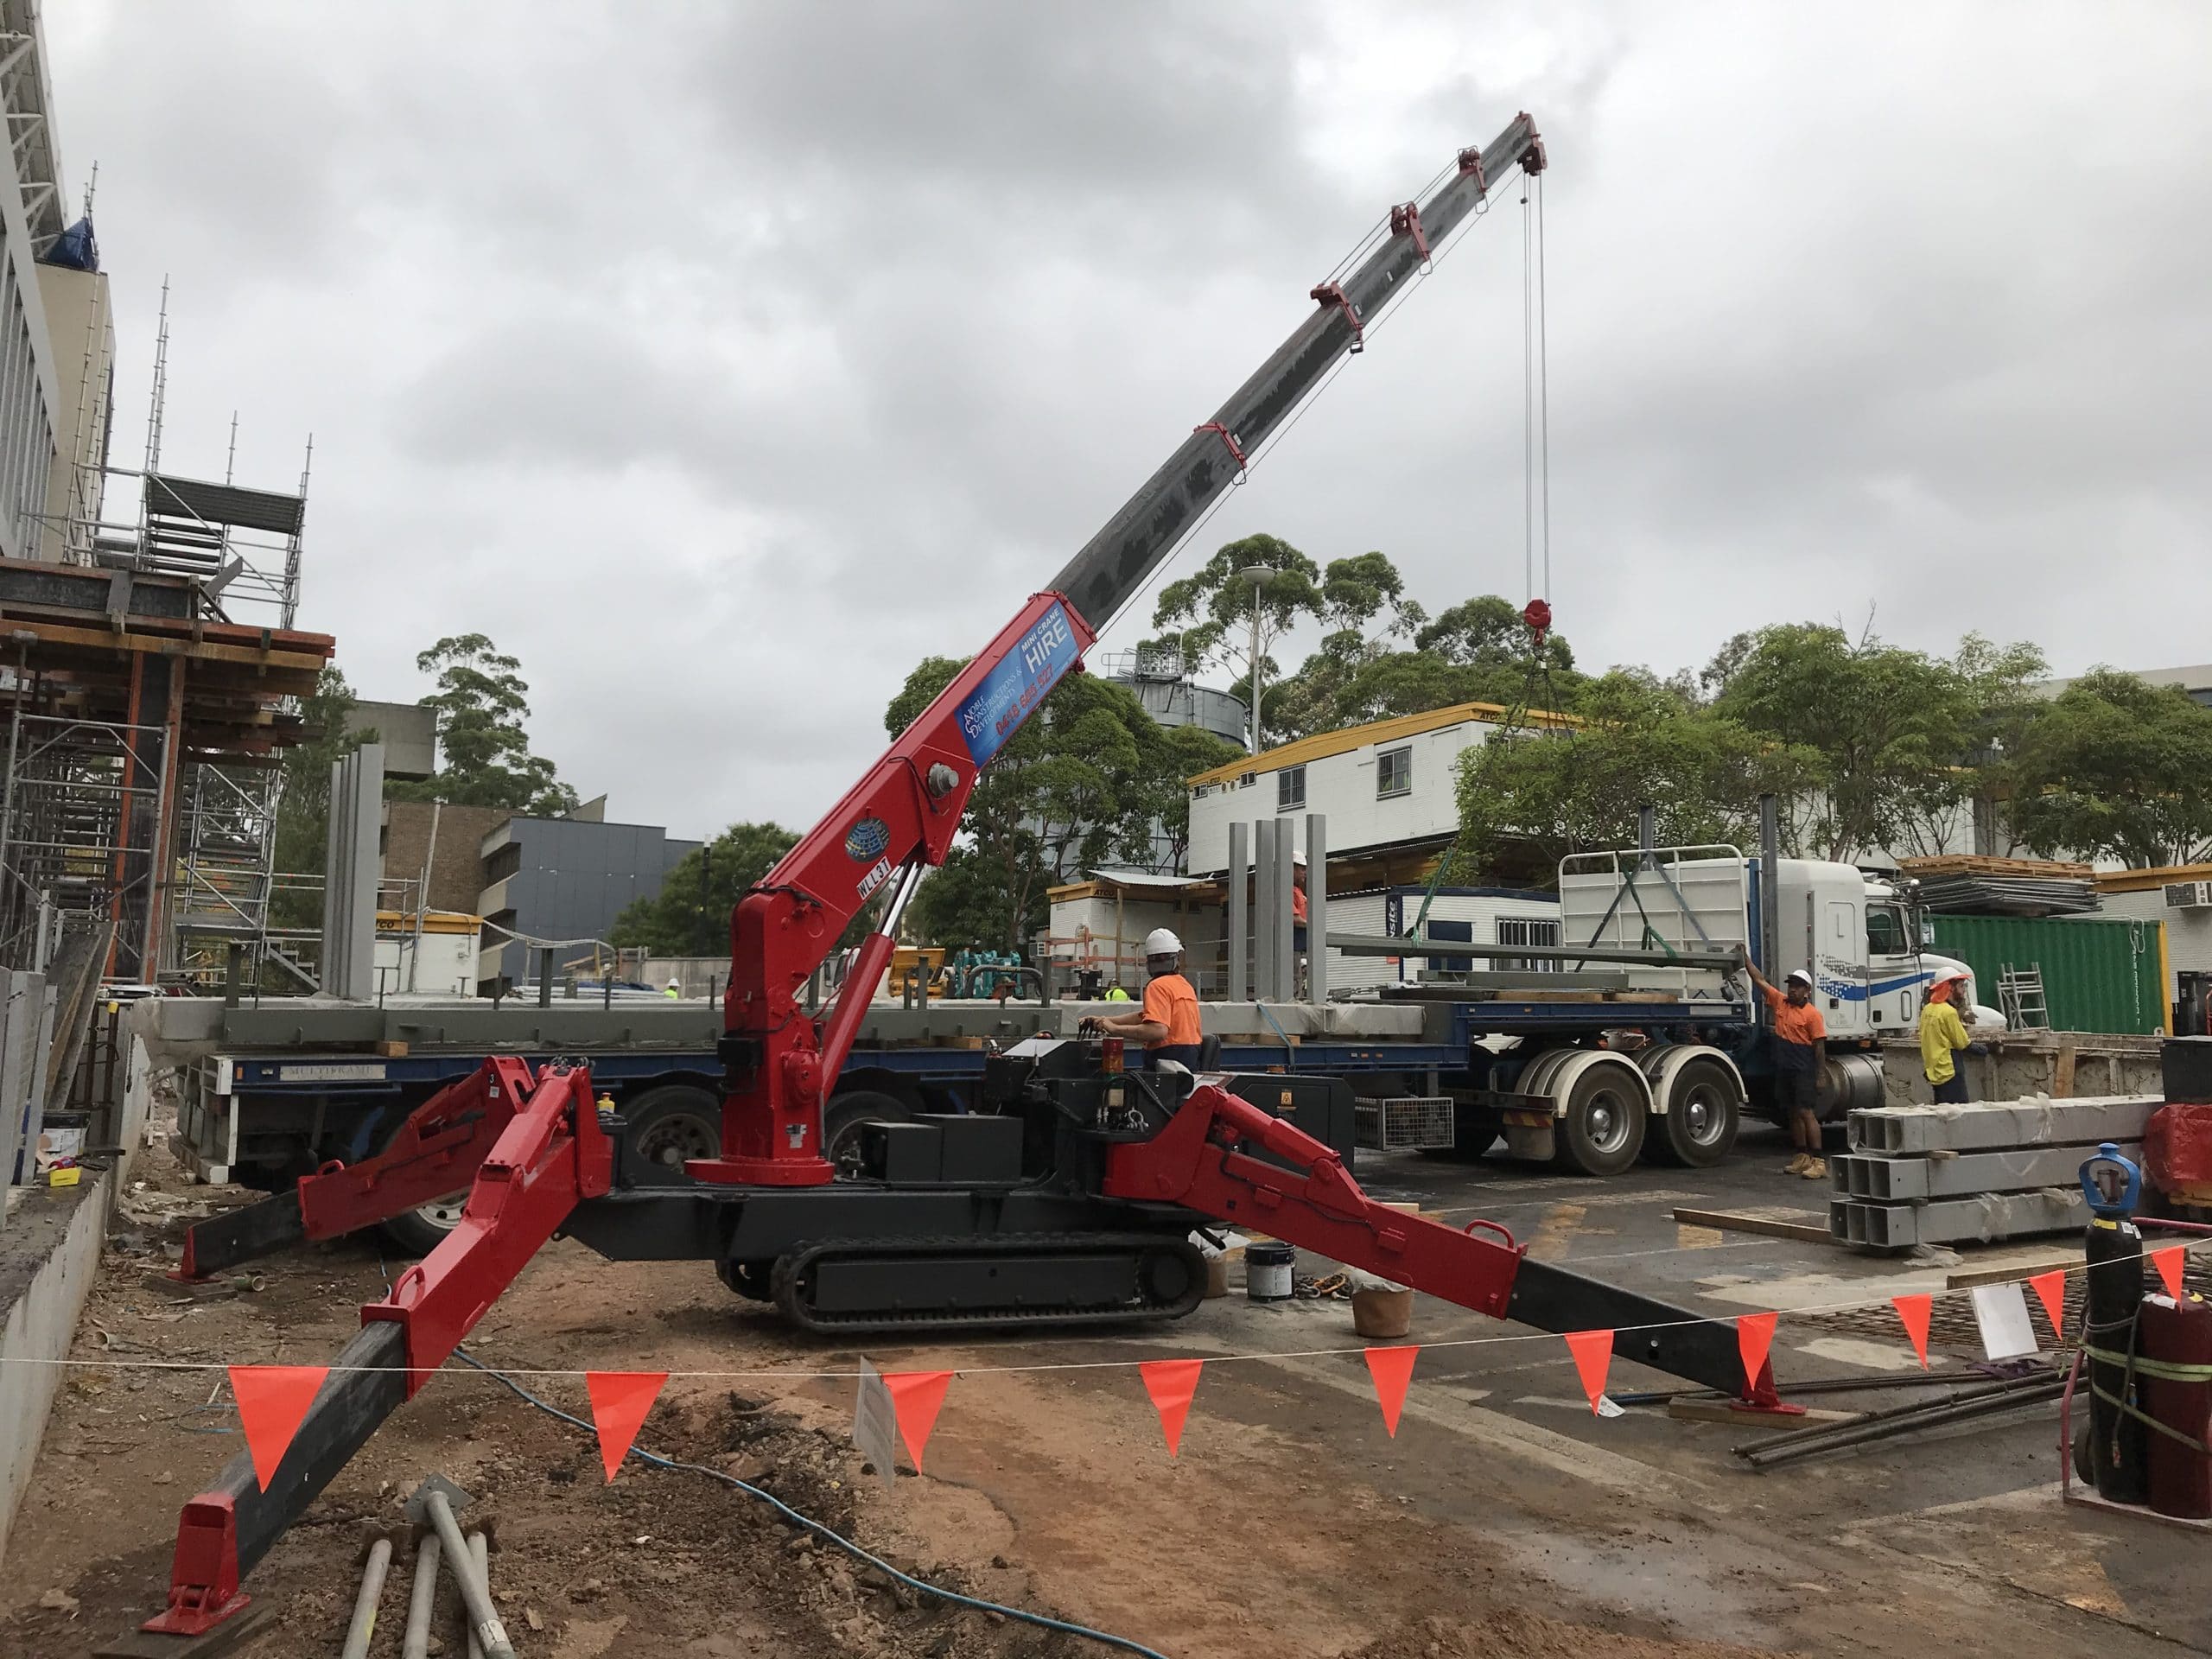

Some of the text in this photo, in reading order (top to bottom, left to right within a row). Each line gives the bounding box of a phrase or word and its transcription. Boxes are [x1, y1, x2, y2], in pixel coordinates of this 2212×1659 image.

[1021, 607, 1060, 652] MINI CRANE
[1026, 617, 1068, 674] HIRE
[963, 695, 985, 725] NOBLE
[1389, 900, 1397, 938] nsite
[489, 1073, 494, 1084] 3
